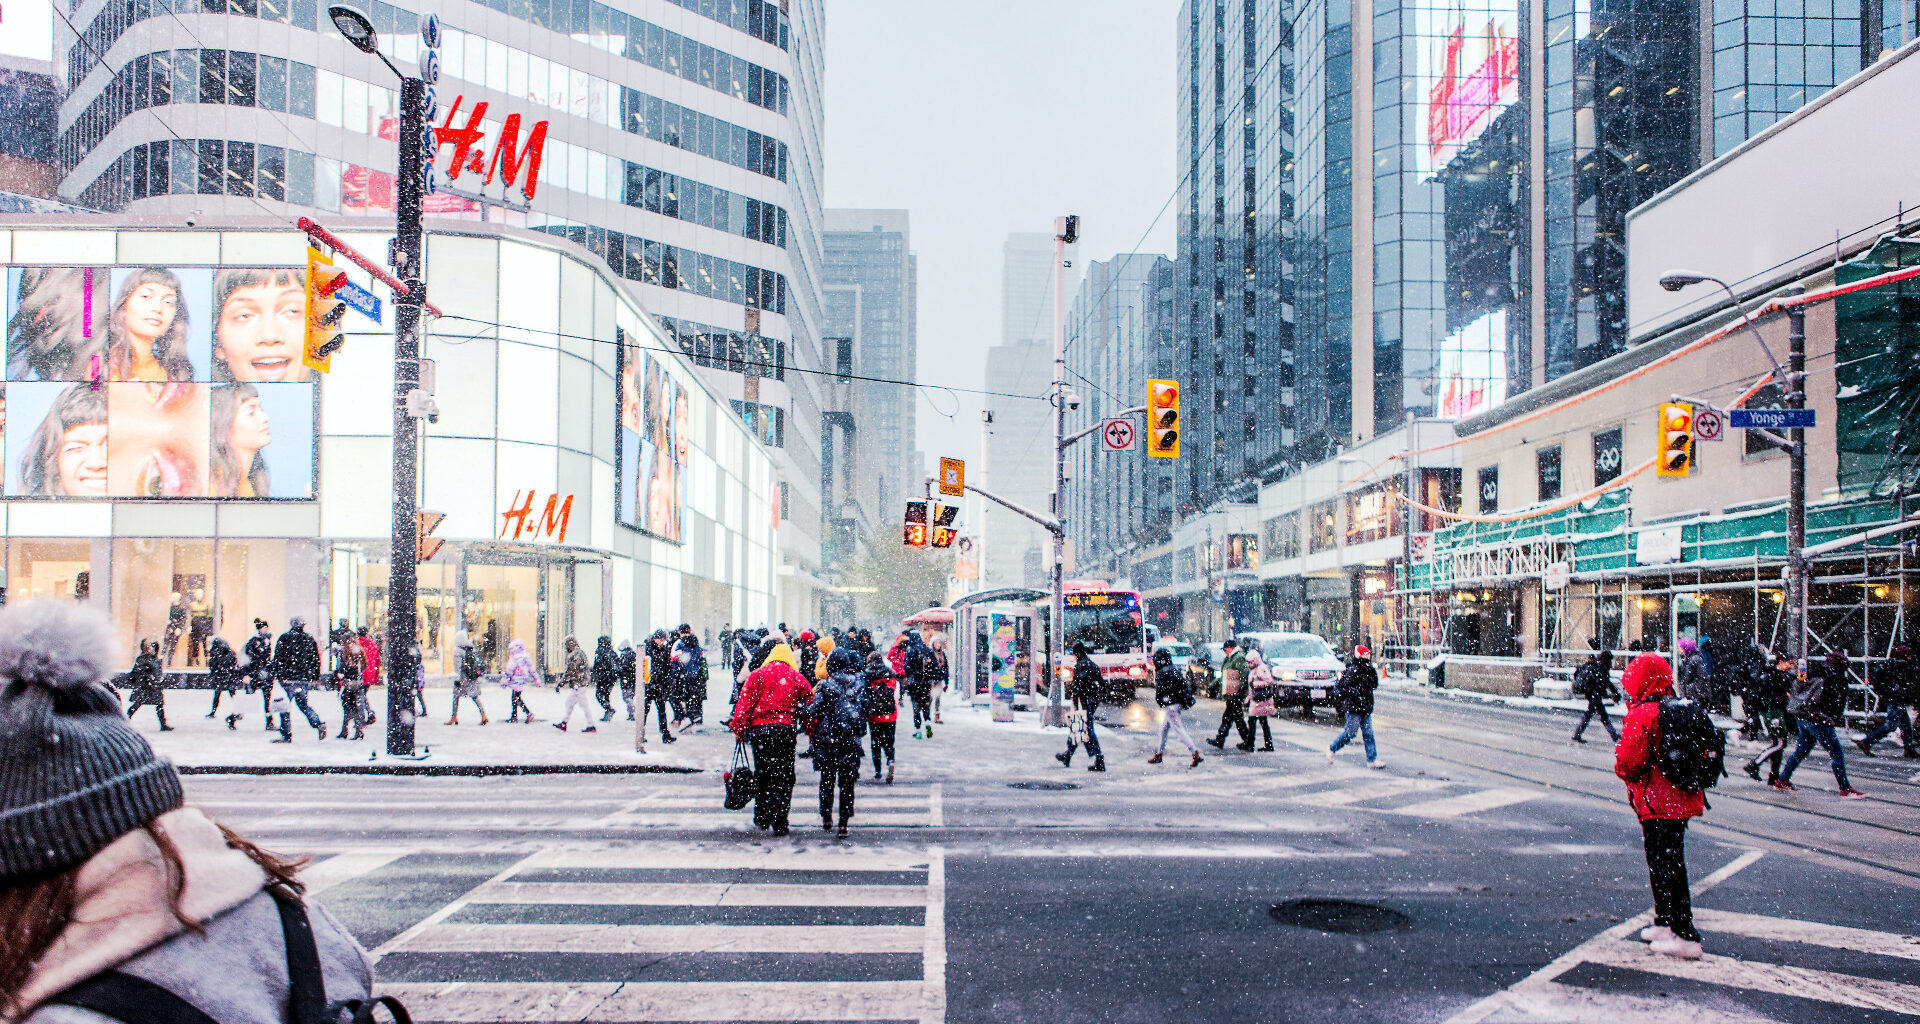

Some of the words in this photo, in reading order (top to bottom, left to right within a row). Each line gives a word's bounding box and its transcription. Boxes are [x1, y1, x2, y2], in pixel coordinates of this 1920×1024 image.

[430, 94, 549, 201] H&M
[1749, 411, 1786, 428] Yonge
[501, 488, 574, 543] H&M
